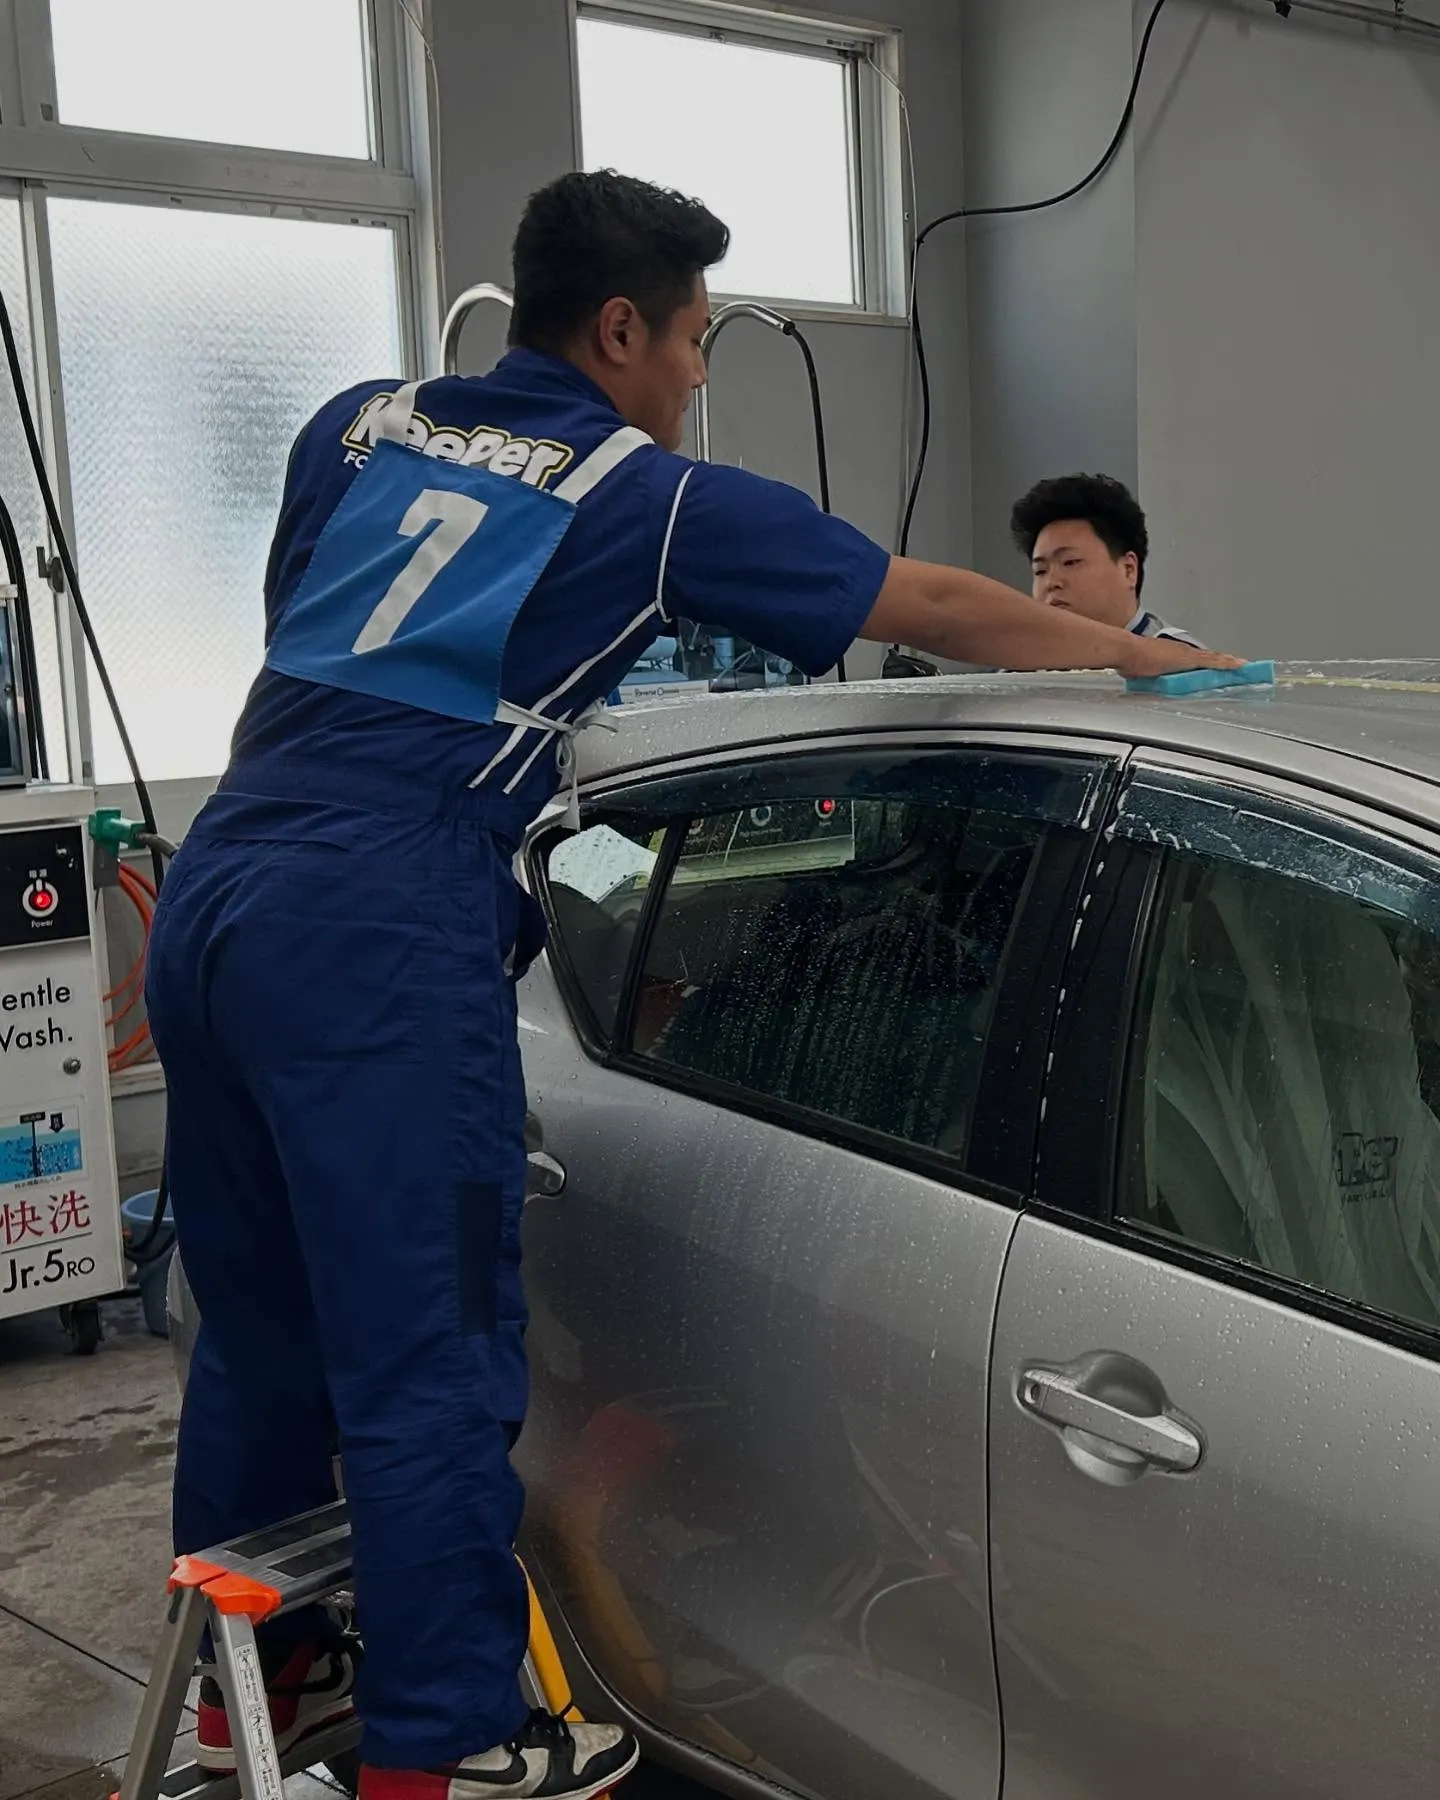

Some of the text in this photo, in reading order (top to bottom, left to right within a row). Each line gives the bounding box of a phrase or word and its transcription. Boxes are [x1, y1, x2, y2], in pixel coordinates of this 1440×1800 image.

[352, 488, 489, 655] 7
[1, 977, 71, 1011] entle
[0, 1190, 91, 1245] 快洗
